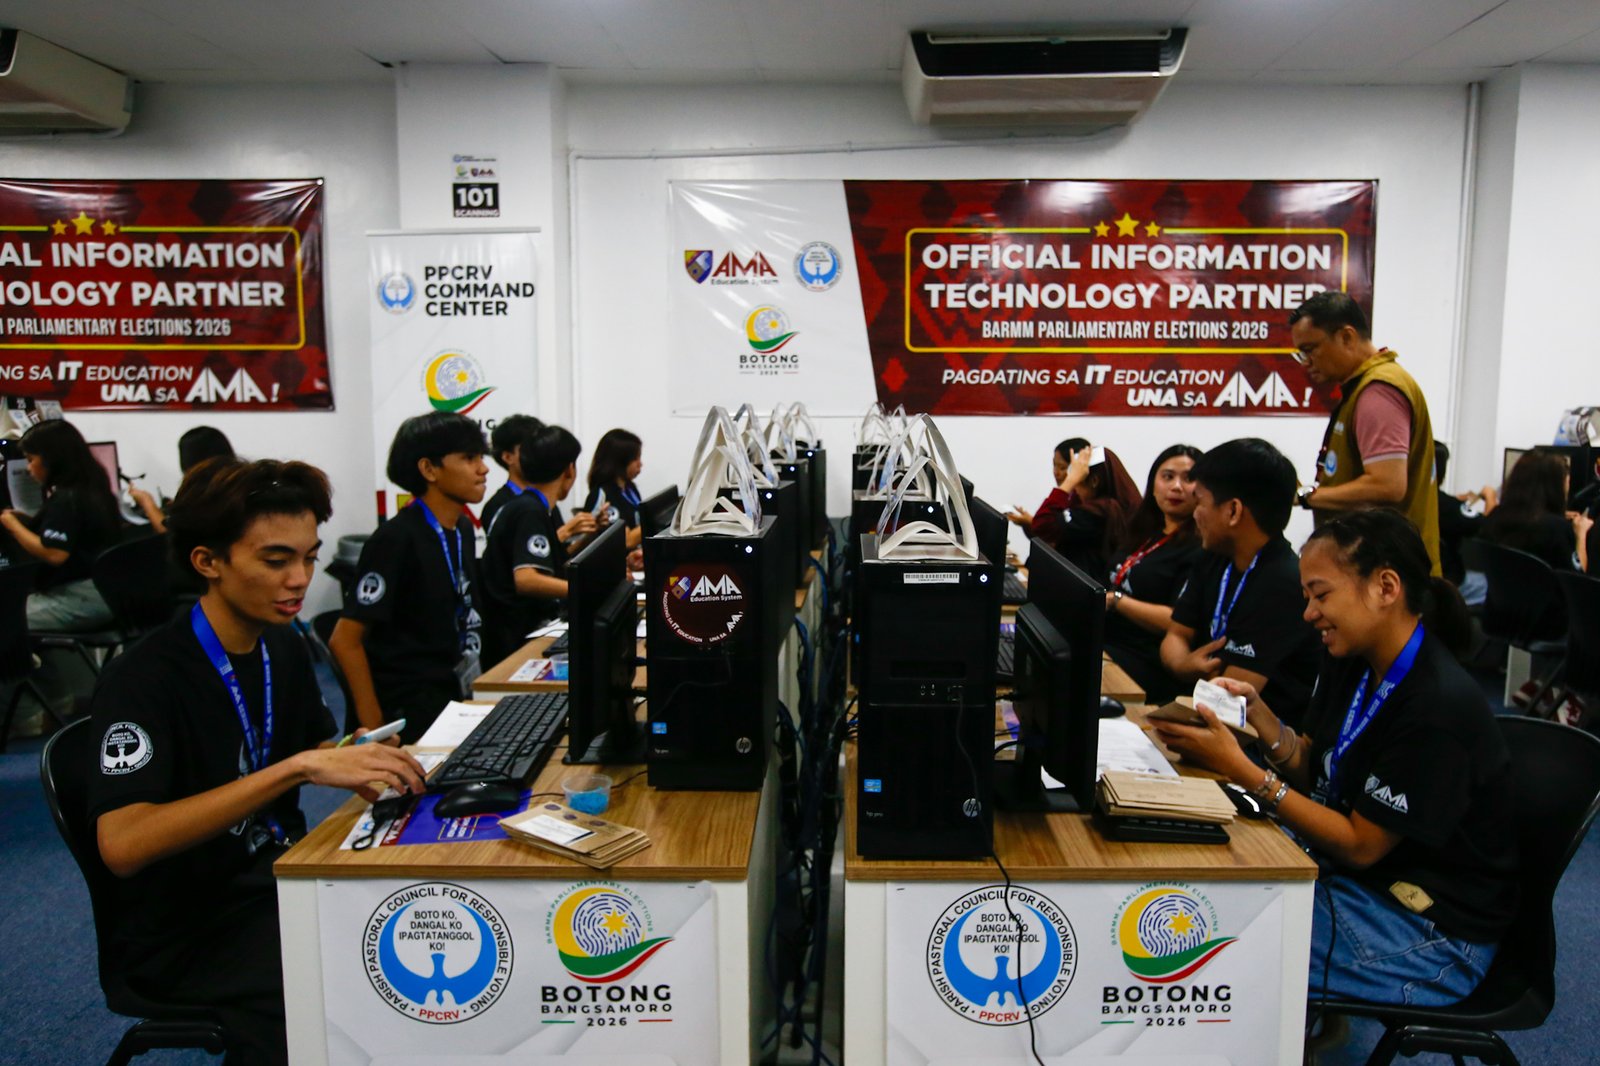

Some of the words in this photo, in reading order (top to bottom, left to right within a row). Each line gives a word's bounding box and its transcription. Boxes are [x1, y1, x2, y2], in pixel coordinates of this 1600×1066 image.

[457, 188, 494, 207] 101
[51, 242, 285, 268] INFORMATION
[712, 250, 778, 277] AMA
[922, 244, 1081, 269] OFFICIAL
[1091, 244, 1331, 270] INFORMATION
[425, 265, 493, 281] PPCRV
[131, 281, 285, 306] PARTNER
[425, 283, 535, 299] COMMAND
[924, 283, 1160, 309] TECHNOLOGY
[425, 301, 509, 316] CENTER
[7, 318, 117, 336] PARLIAMENTARY
[120, 318, 192, 336] ELECTIONS
[195, 318, 231, 336] 2026
[982, 320, 1034, 339] BARMM
[1038, 321, 1150, 339] PARLIAMENTARY
[1154, 321, 1228, 339] ELECTIONS
[1232, 321, 1269, 339] 2026
[740, 354, 799, 364] BOTONG
[29, 365, 53, 380] SA
[57, 361, 83, 381] IT
[86, 366, 193, 381] EDUCATION
[942, 369, 1051, 385] PAGDATING
[1055, 369, 1079, 385] SA
[1084, 365, 1112, 385] IT
[1113, 369, 1225, 385] EDUCATION
[100, 384, 151, 402] UNA
[155, 387, 180, 402] SA
[1127, 388, 1178, 407] UNA
[1182, 391, 1207, 407] SA
[690, 574, 742, 596] AMA
[690, 595, 720, 603] Education
[720, 594, 743, 602] System
[387, 887, 439, 912] COUNCIL
[442, 887, 468, 902] FOR
[954, 890, 1006, 915] COUNCIL
[1010, 890, 1036, 905] FOR
[414, 911, 440, 920] BOTO
[551, 880, 622, 909] PARLIAMENTARY
[623, 888, 654, 932] ELECTIONS
[1118, 880, 1190, 911] PARLIAMENTARY
[1192, 887, 1219, 932] ELECTIONS
[410, 921, 447, 930] DANGAL
[449, 921, 462, 930] KO
[981, 914, 1006, 922] BOTO
[399, 931, 475, 941] IPAGTATANGGOL
[468, 897, 509, 975] RESPONSIBLE
[976, 924, 1013, 933] DANGAL
[367, 912, 390, 973] PASTORAL
[429, 942, 446, 951] KO!
[930, 916, 956, 976] PASTORAL
[1036, 901, 1073, 977] RESPONSIBLE
[994, 945, 1010, 954] KO!
[373, 973, 408, 1011] PARISH
[470, 977, 504, 1013] VOTING
[541, 984, 671, 1003] BOTONG
[935, 977, 970, 1013] PARISH
[1031, 978, 1067, 1014] VOTING
[1103, 984, 1231, 1003] BOTONG
[418, 1008, 460, 1021] PPCRV
[541, 1003, 672, 1014] BANGSAMORO
[979, 1010, 1020, 1022] PPCRV
[1101, 1003, 1231, 1014] BANGSAMORO
[587, 1017, 628, 1027] 2026
[1146, 1017, 1186, 1027] 2026
